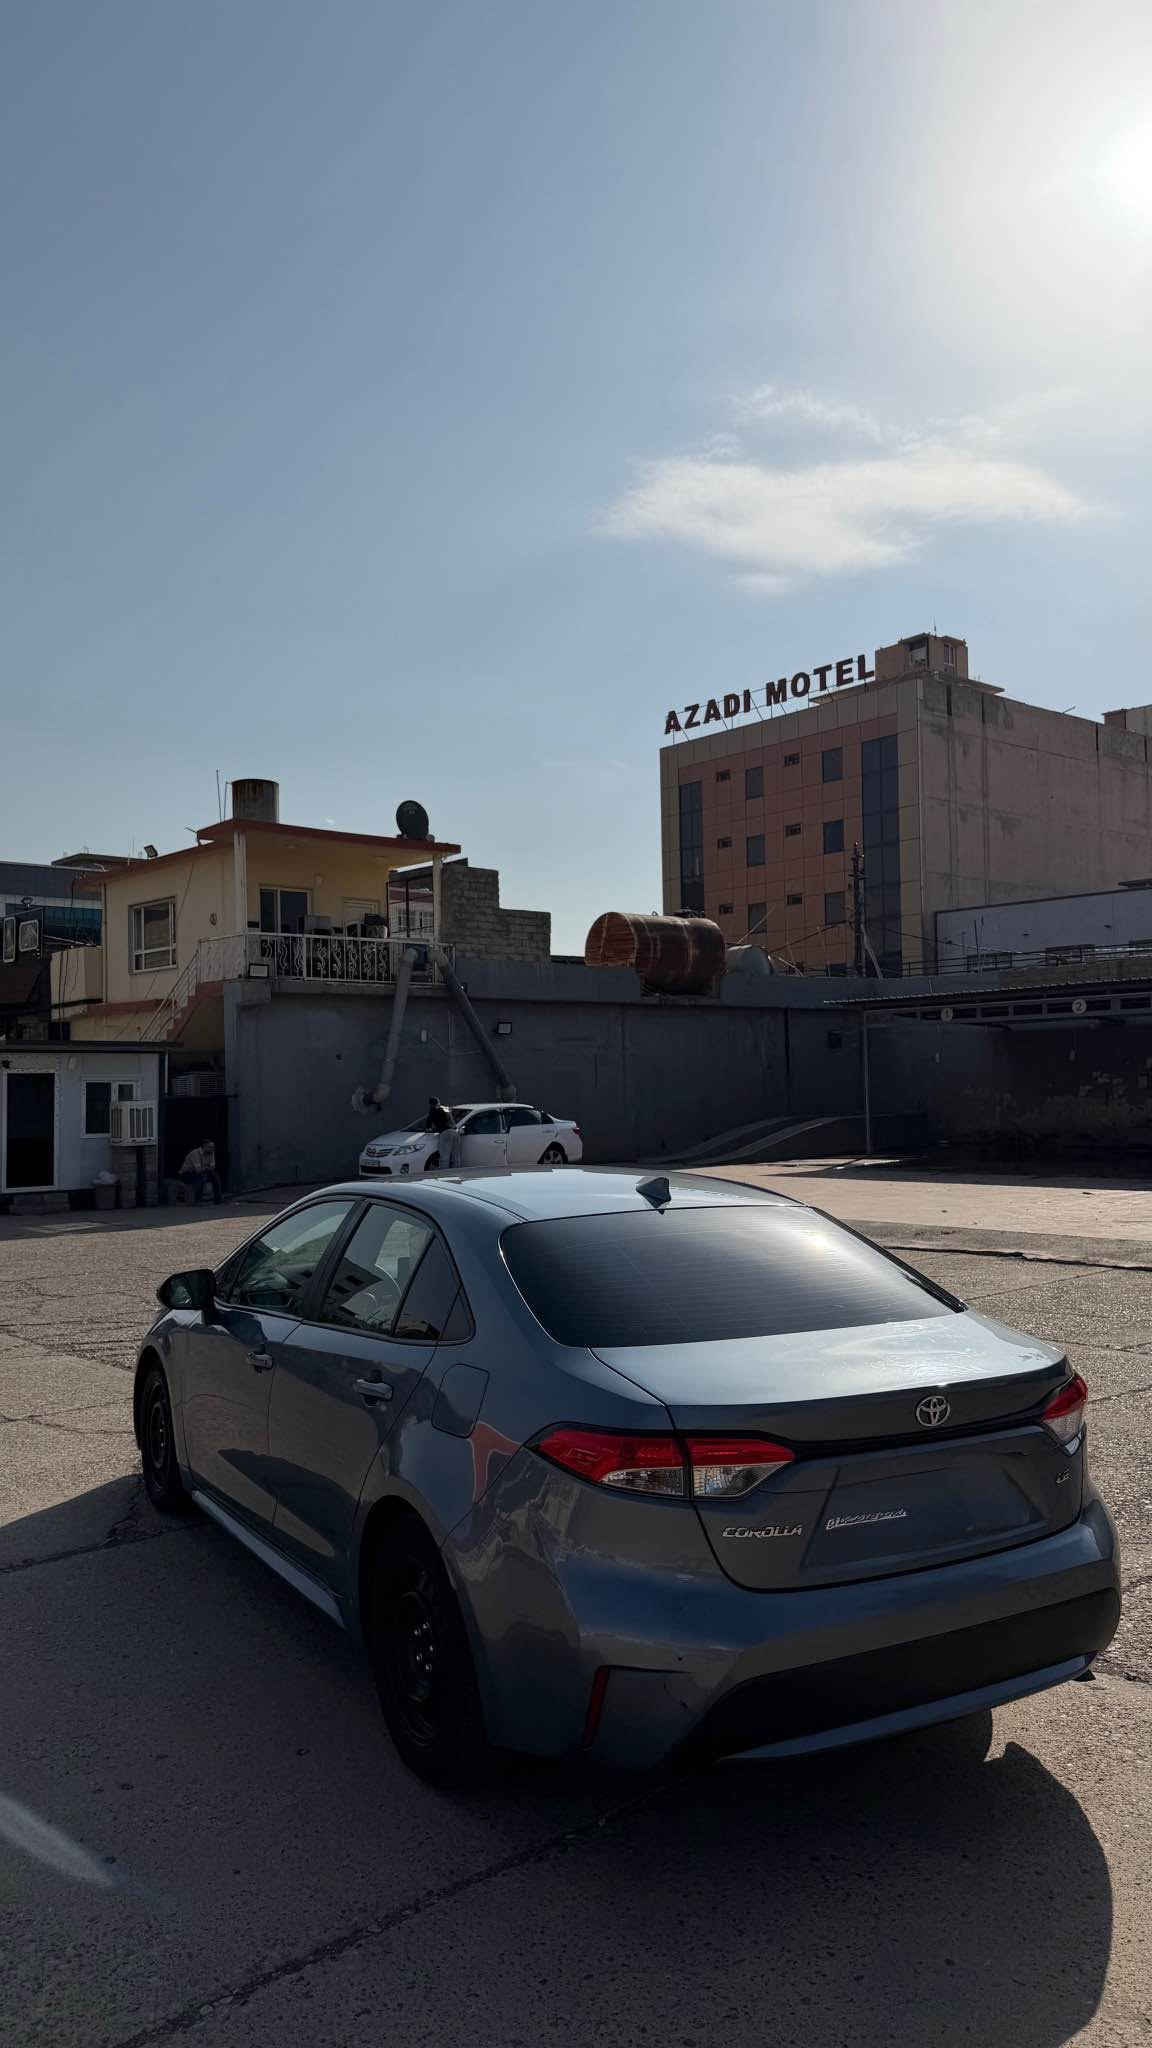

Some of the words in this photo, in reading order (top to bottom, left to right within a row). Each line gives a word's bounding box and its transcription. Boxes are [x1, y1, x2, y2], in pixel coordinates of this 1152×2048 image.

[664, 689, 751, 735] AZADI
[766, 654, 875, 706] MOTEL
[722, 1525, 803, 1540] COROLLA
